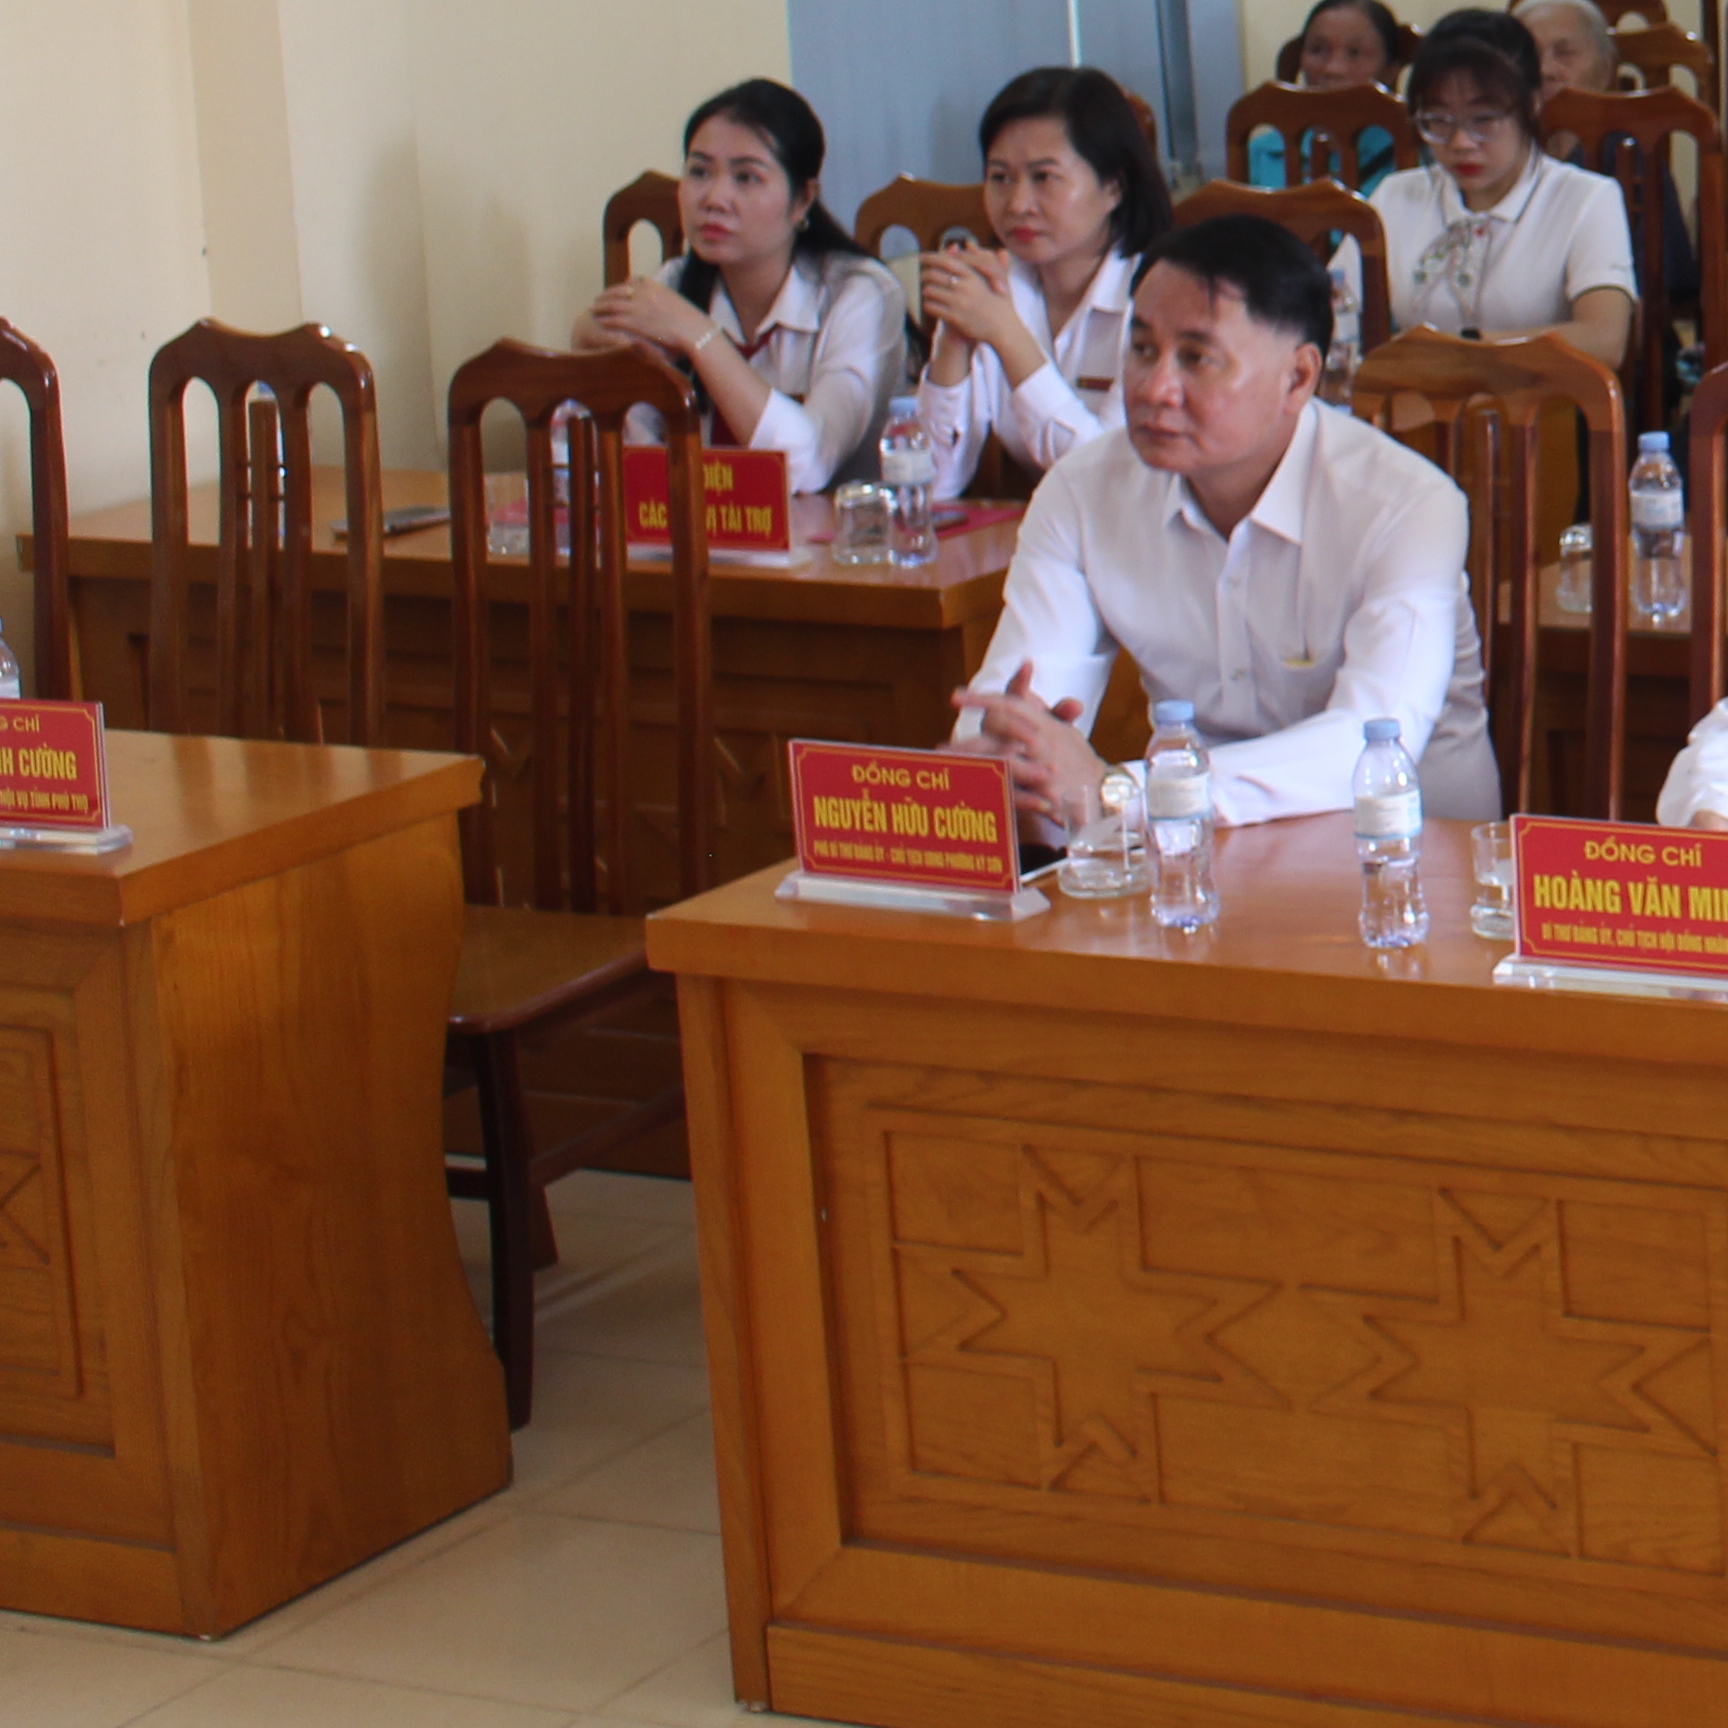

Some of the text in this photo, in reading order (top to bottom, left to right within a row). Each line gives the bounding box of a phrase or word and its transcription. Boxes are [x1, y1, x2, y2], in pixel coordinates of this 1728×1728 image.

[638, 498, 668, 530] CÁC
[720, 501, 742, 533] TÀI
[746, 505, 773, 538] TRỢ
[13, 714, 40, 732] CHÍ
[19, 742, 78, 780] CƯỜNG
[852, 759, 950, 791] ĐỒNG CHÍ
[813, 788, 998, 843] NGUYỄN HỮU CƯỜNG
[1584, 835, 1702, 867] ĐỒNG CHÍ
[1533, 869, 1621, 914] HOÀNG
[1627, 875, 1681, 919] VĂN
